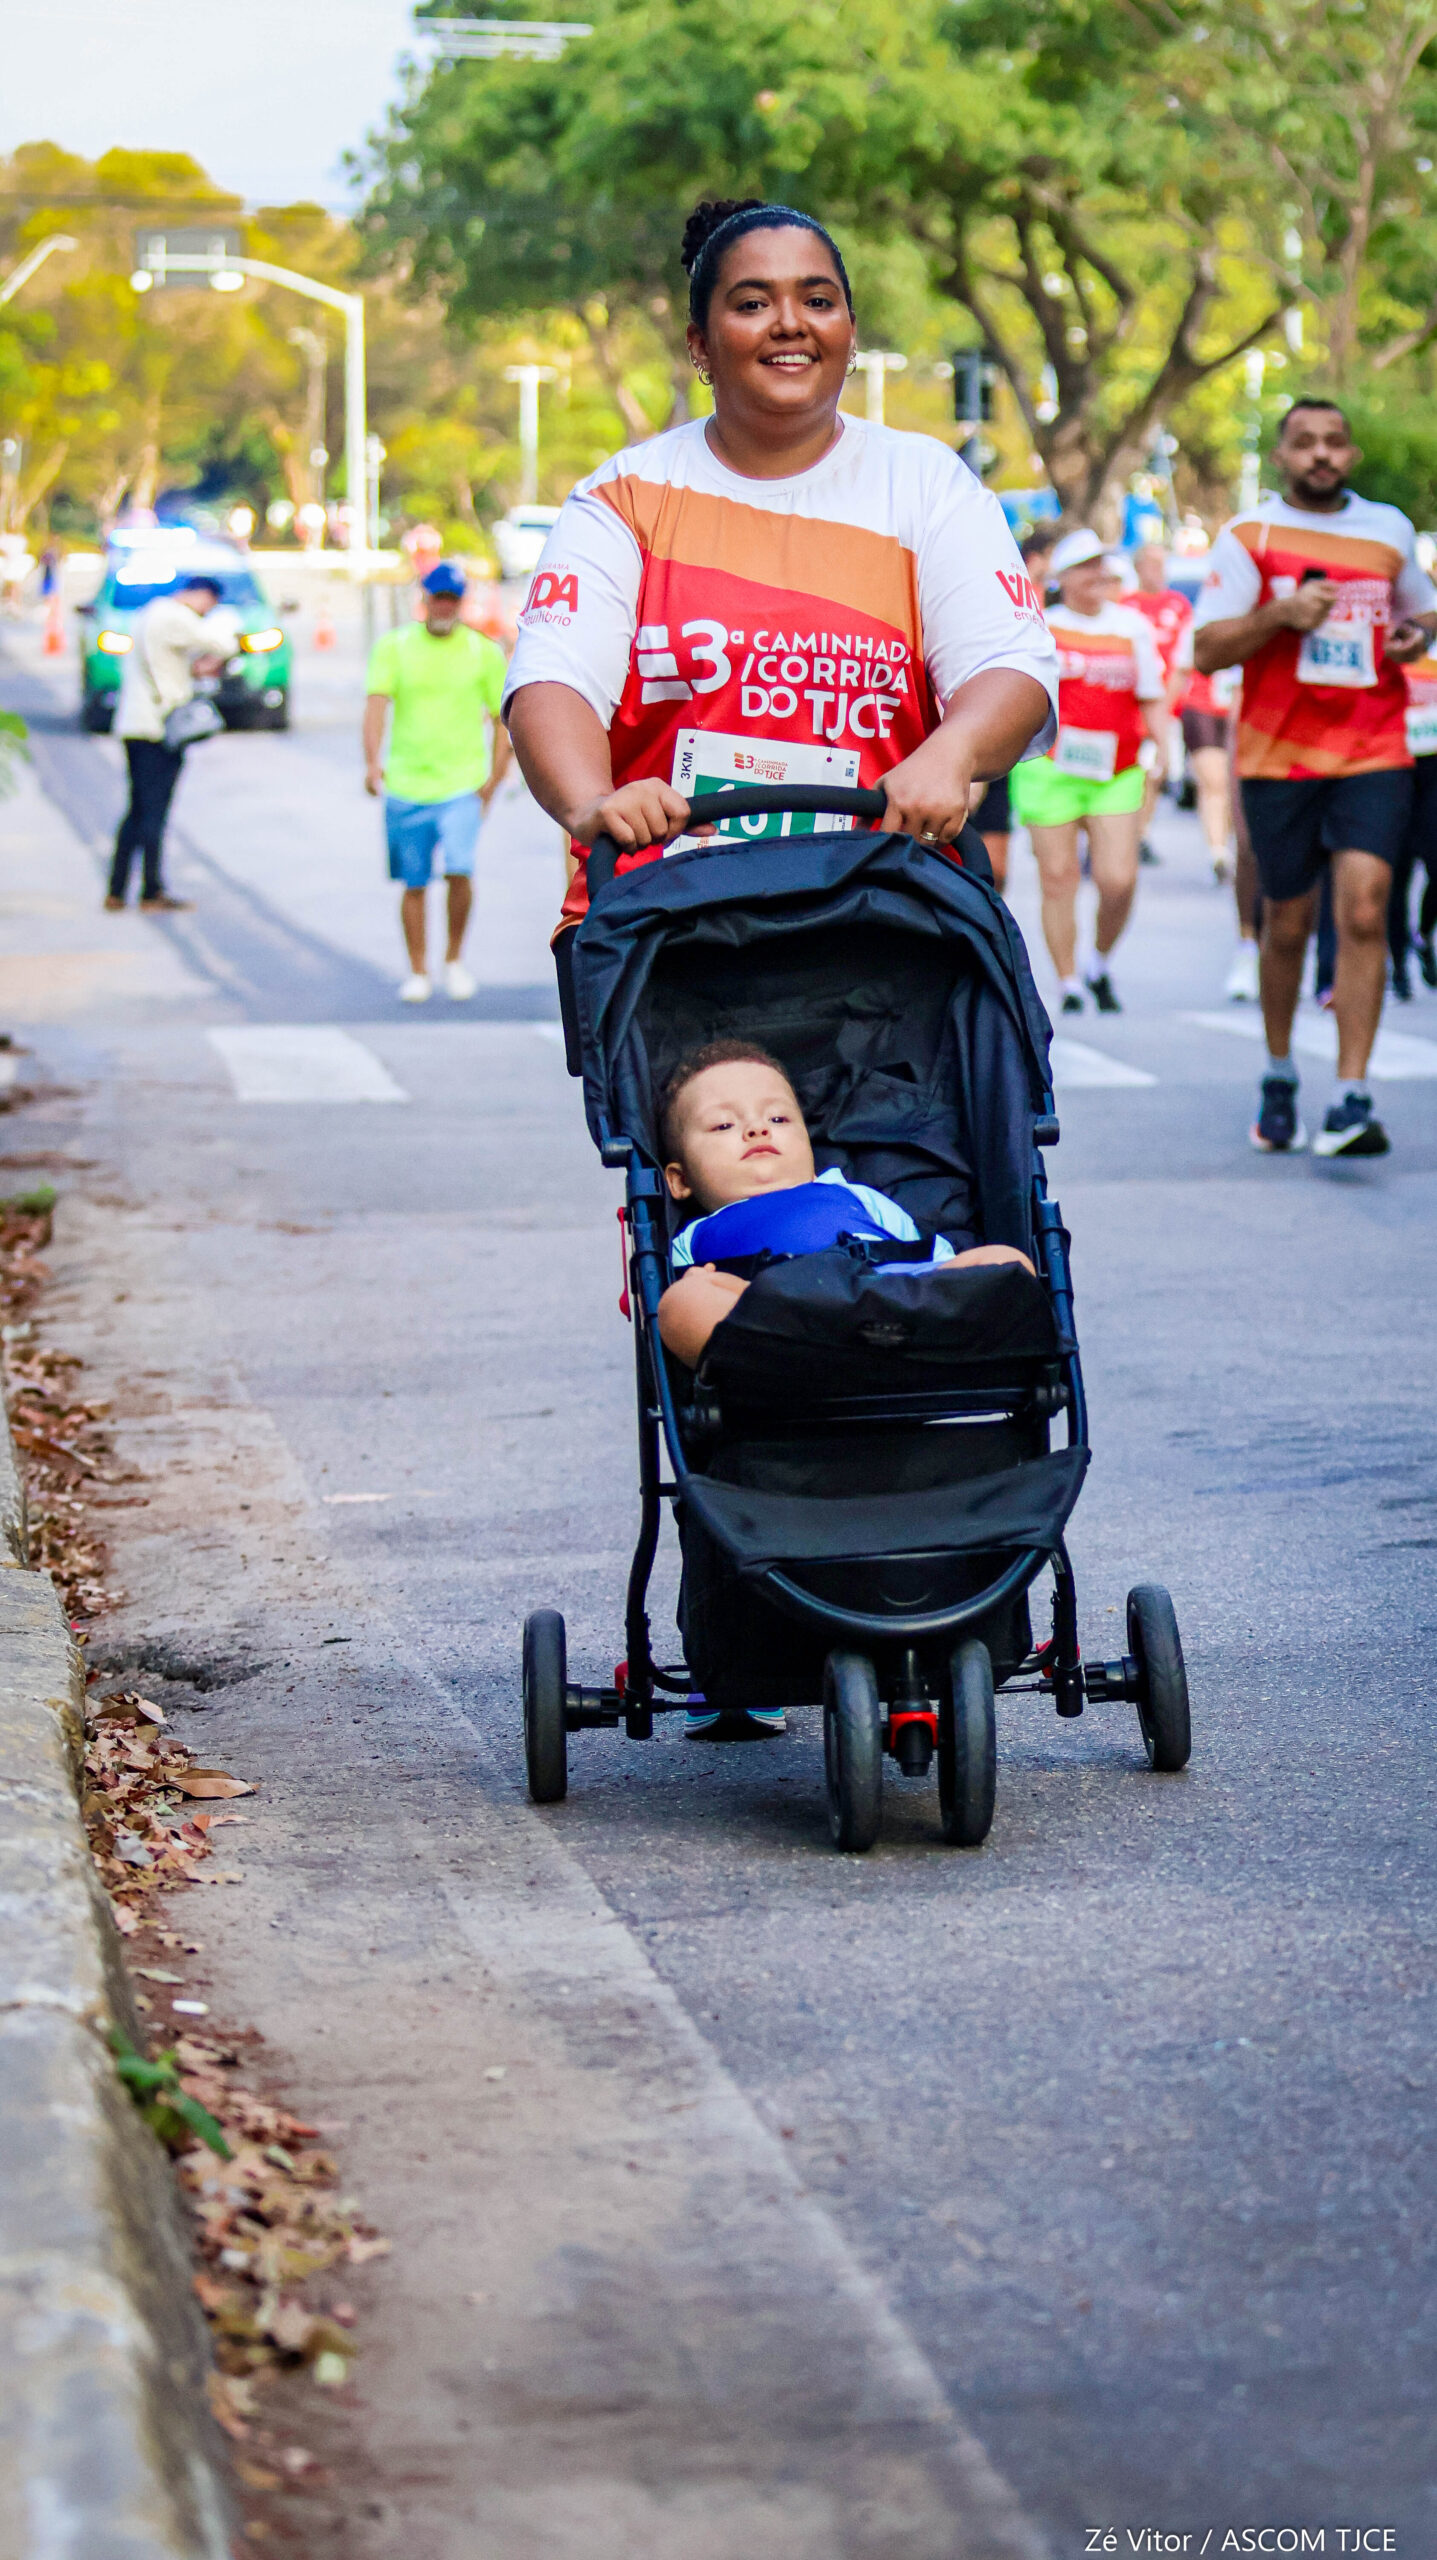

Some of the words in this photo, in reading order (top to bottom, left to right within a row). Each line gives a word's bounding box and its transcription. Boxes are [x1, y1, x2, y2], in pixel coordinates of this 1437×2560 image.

[741, 685, 798, 719] DO
[803, 689, 901, 741] TJCE
[680, 751, 694, 780] 3KM
[765, 770, 785, 781] TJCE
